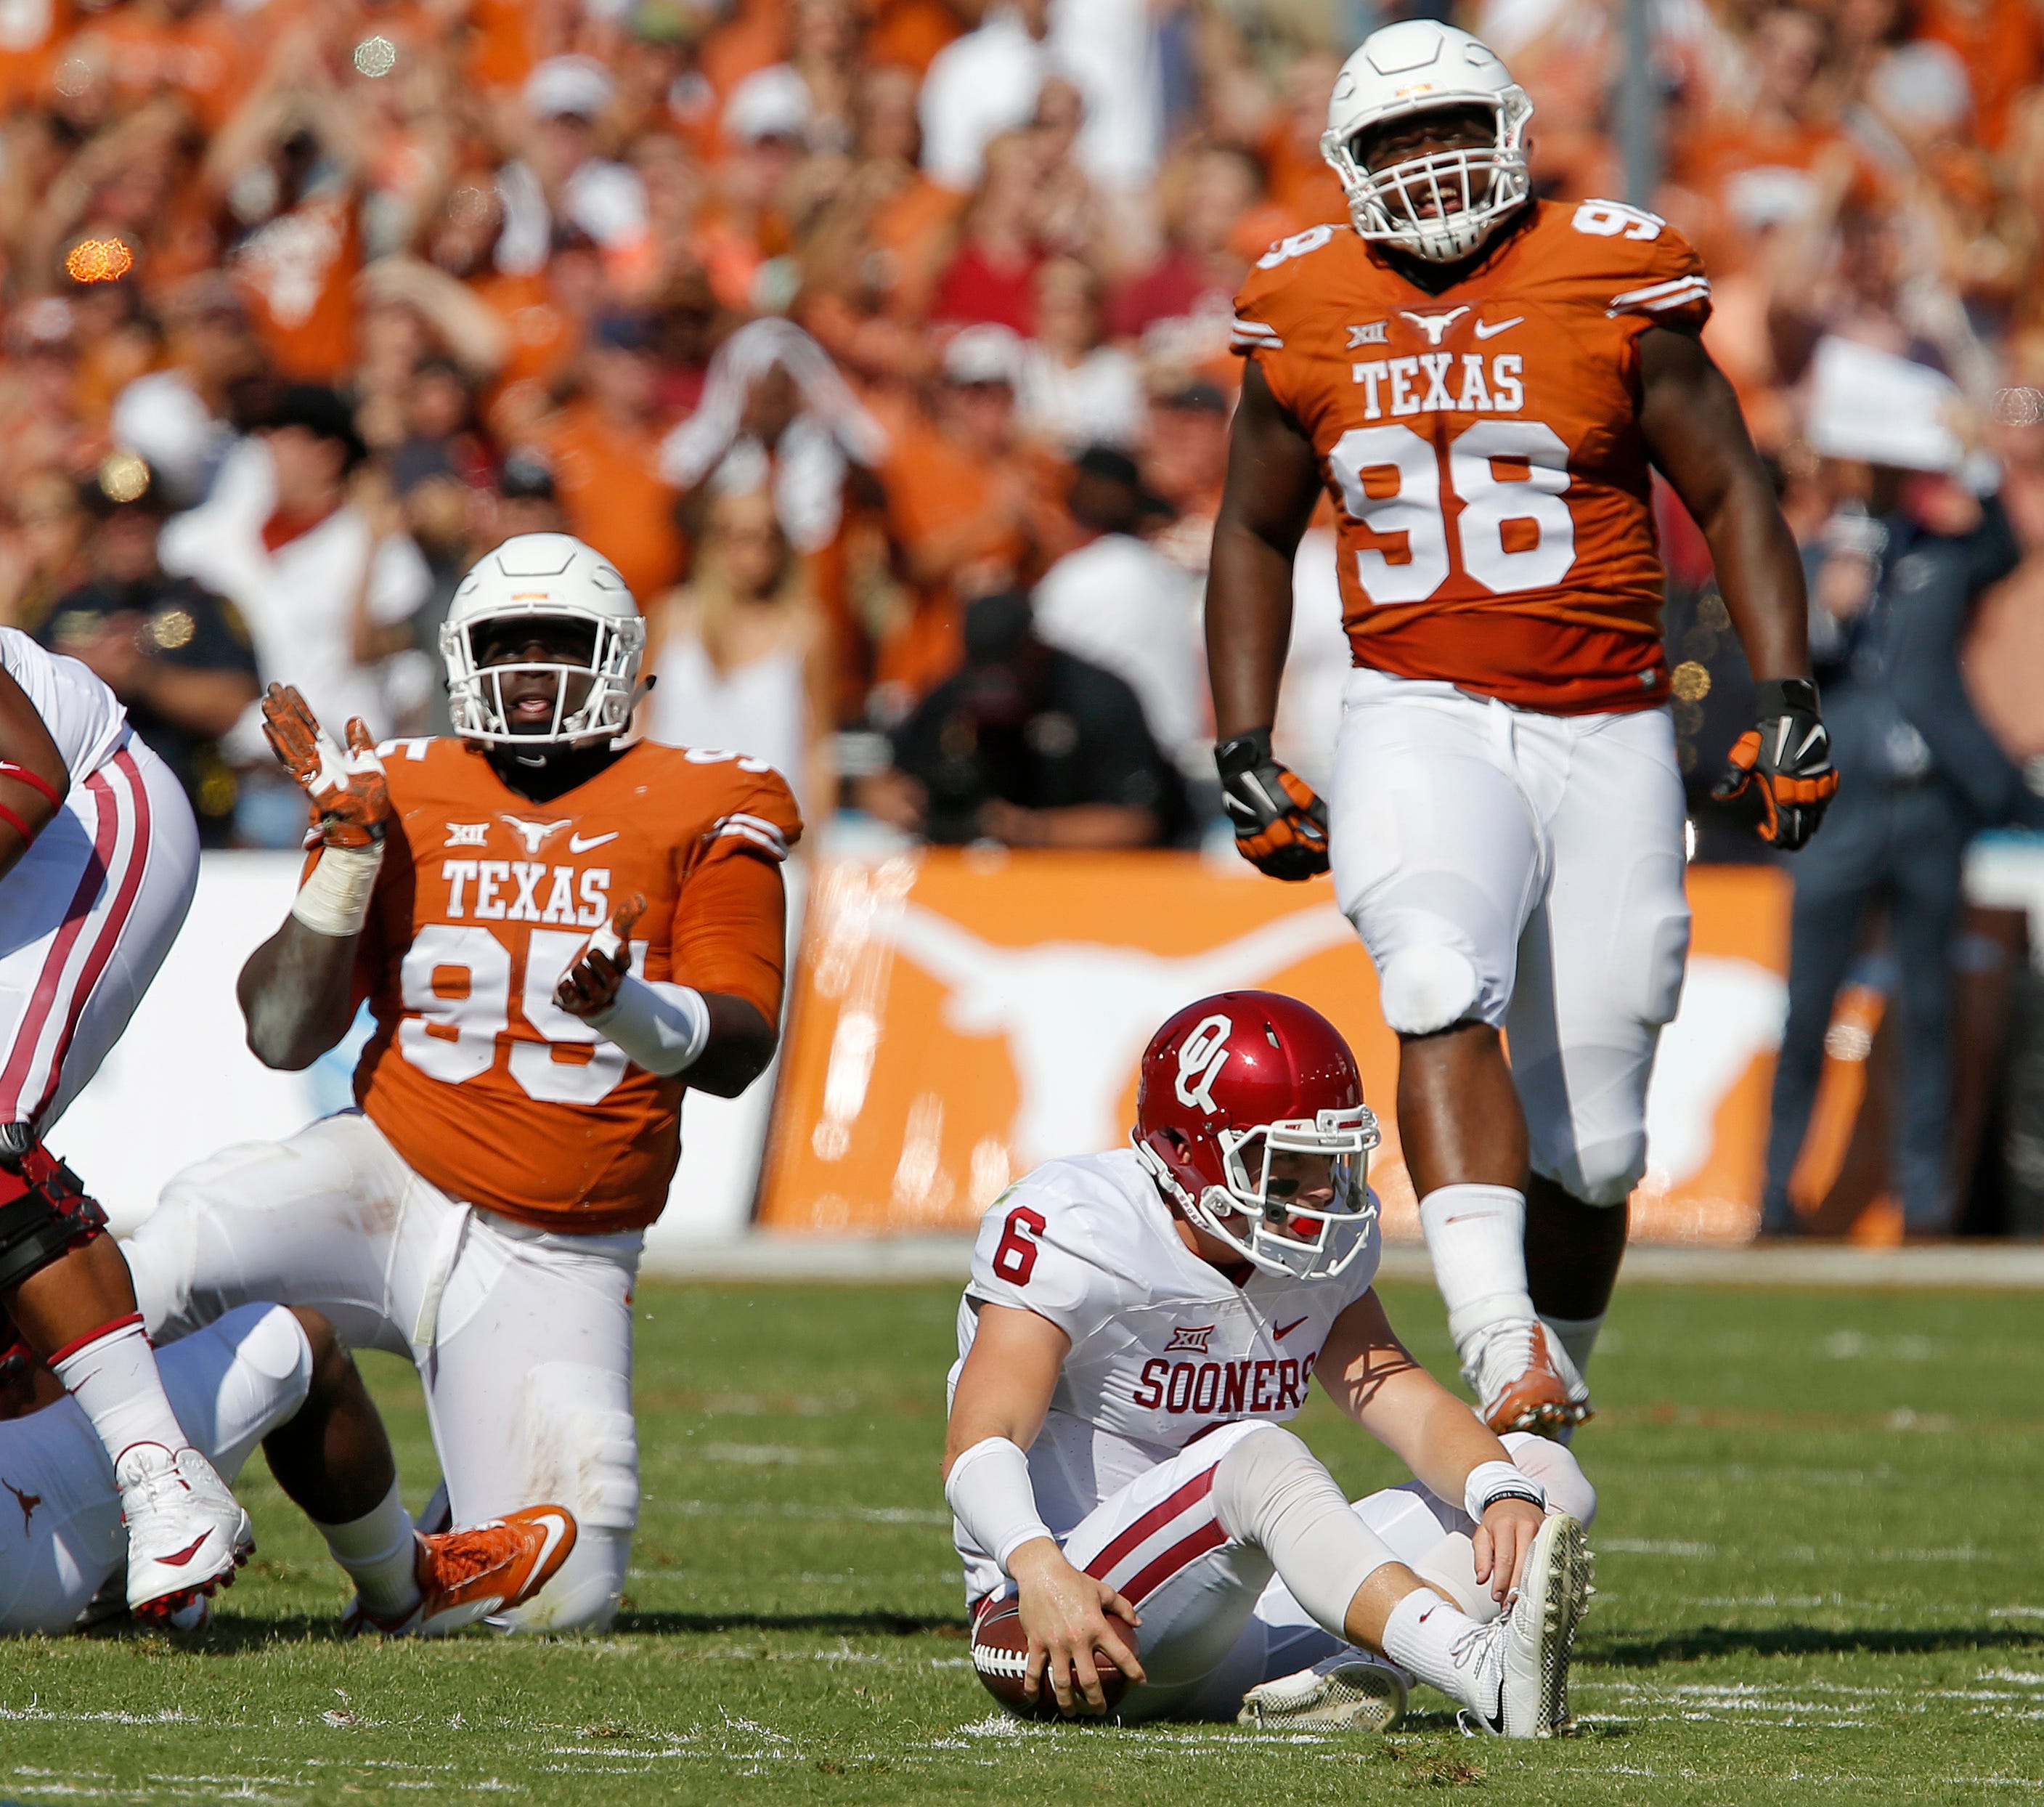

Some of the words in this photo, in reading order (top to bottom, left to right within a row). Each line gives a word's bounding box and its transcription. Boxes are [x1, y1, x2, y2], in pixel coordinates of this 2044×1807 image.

[1352, 352, 1524, 421] TEXAS
[1328, 419, 1577, 605] 98
[441, 858, 611, 928] TEXAS
[399, 923, 649, 1105] 95
[993, 1206, 1046, 1287] 6
